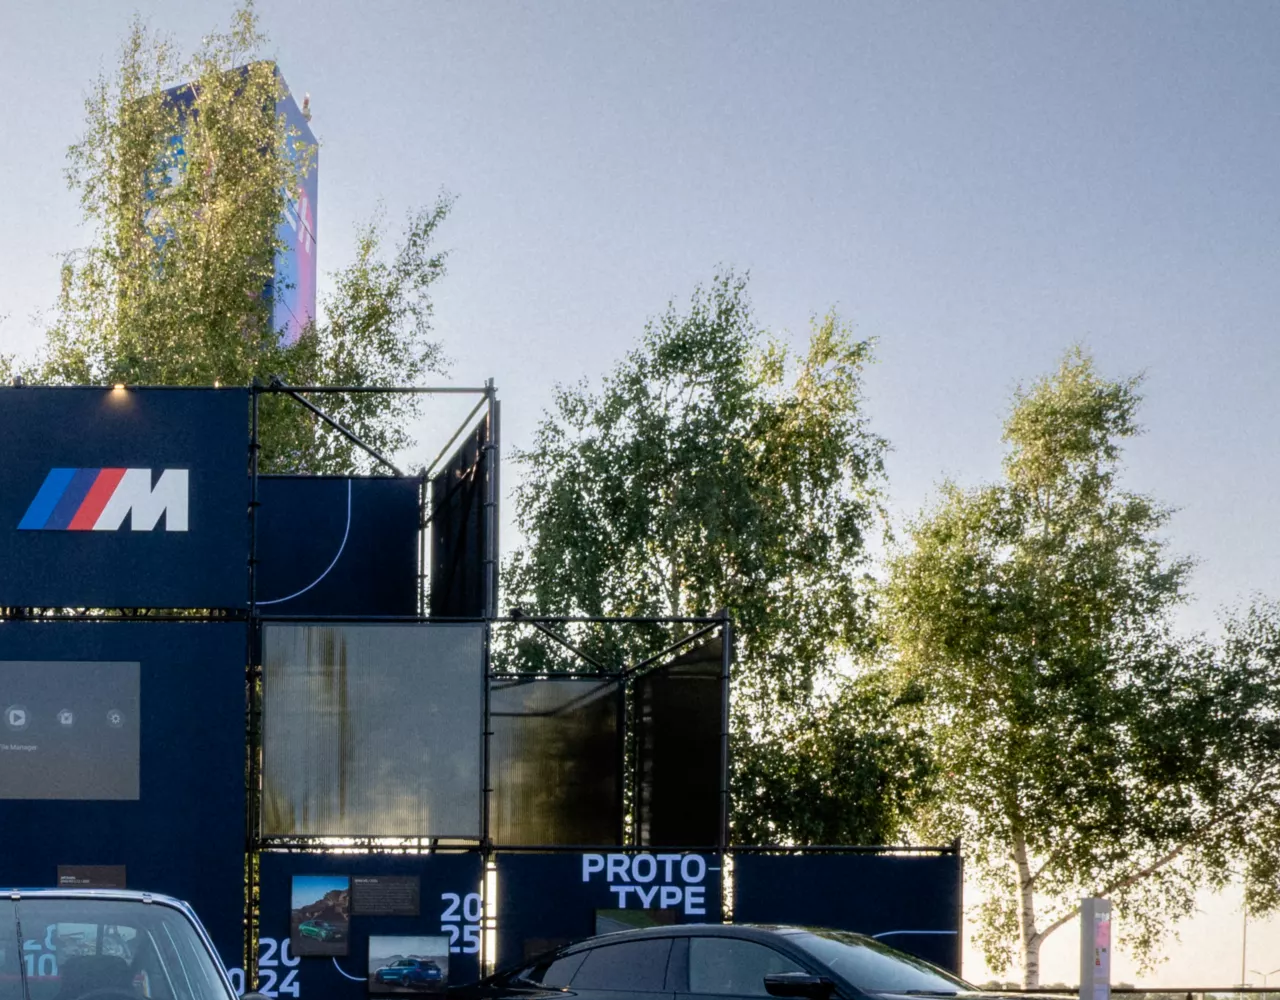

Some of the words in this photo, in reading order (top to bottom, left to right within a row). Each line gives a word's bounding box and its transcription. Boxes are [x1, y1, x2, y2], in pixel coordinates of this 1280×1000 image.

[92, 468, 189, 531] M
[583, 854, 706, 883] PROTO
[440, 892, 482, 922] 20
[610, 886, 706, 915] TYPE
[258, 938, 301, 967] 20
[440, 925, 481, 954] 25
[23, 953, 58, 977] 10
[258, 968, 300, 998] 24
